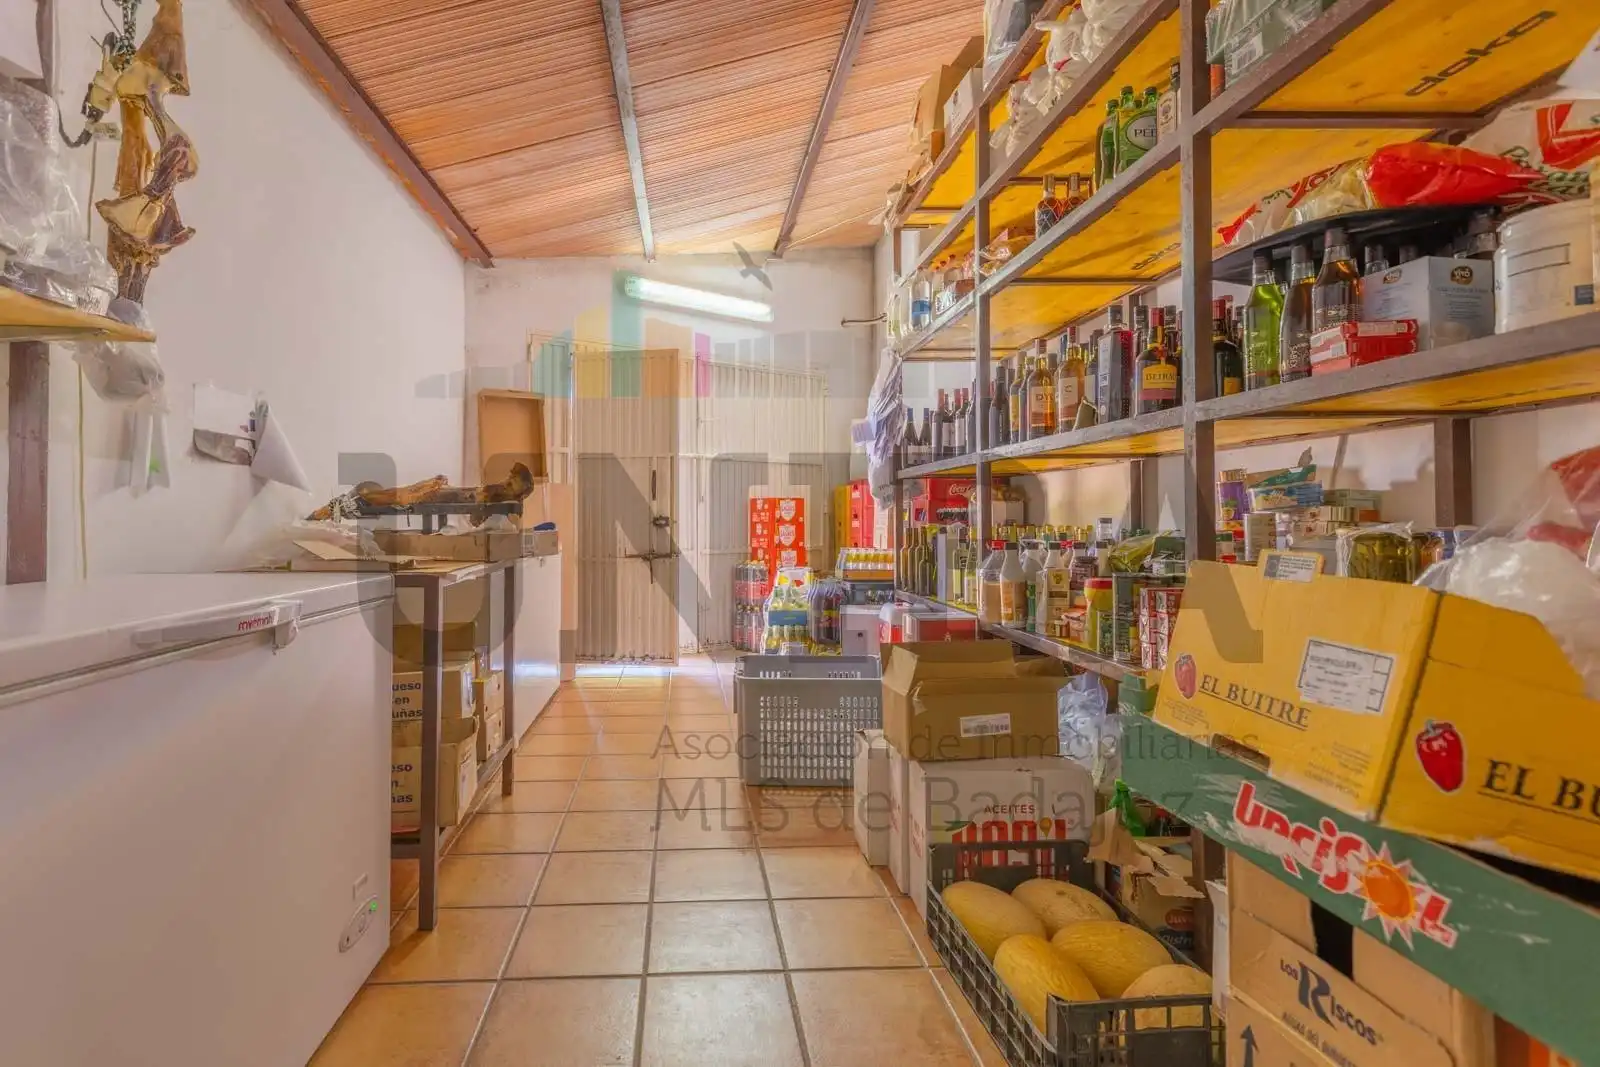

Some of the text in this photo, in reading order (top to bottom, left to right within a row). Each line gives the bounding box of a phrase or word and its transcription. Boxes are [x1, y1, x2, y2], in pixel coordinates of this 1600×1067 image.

[392, 681, 421, 691] ueso
[1200, 674, 1220, 695] EL
[1226, 683, 1312, 728] BUITRE
[391, 708, 423, 719] uñas
[1480, 758, 1600, 818] EL B
[984, 804, 1035, 814] ACEITES
